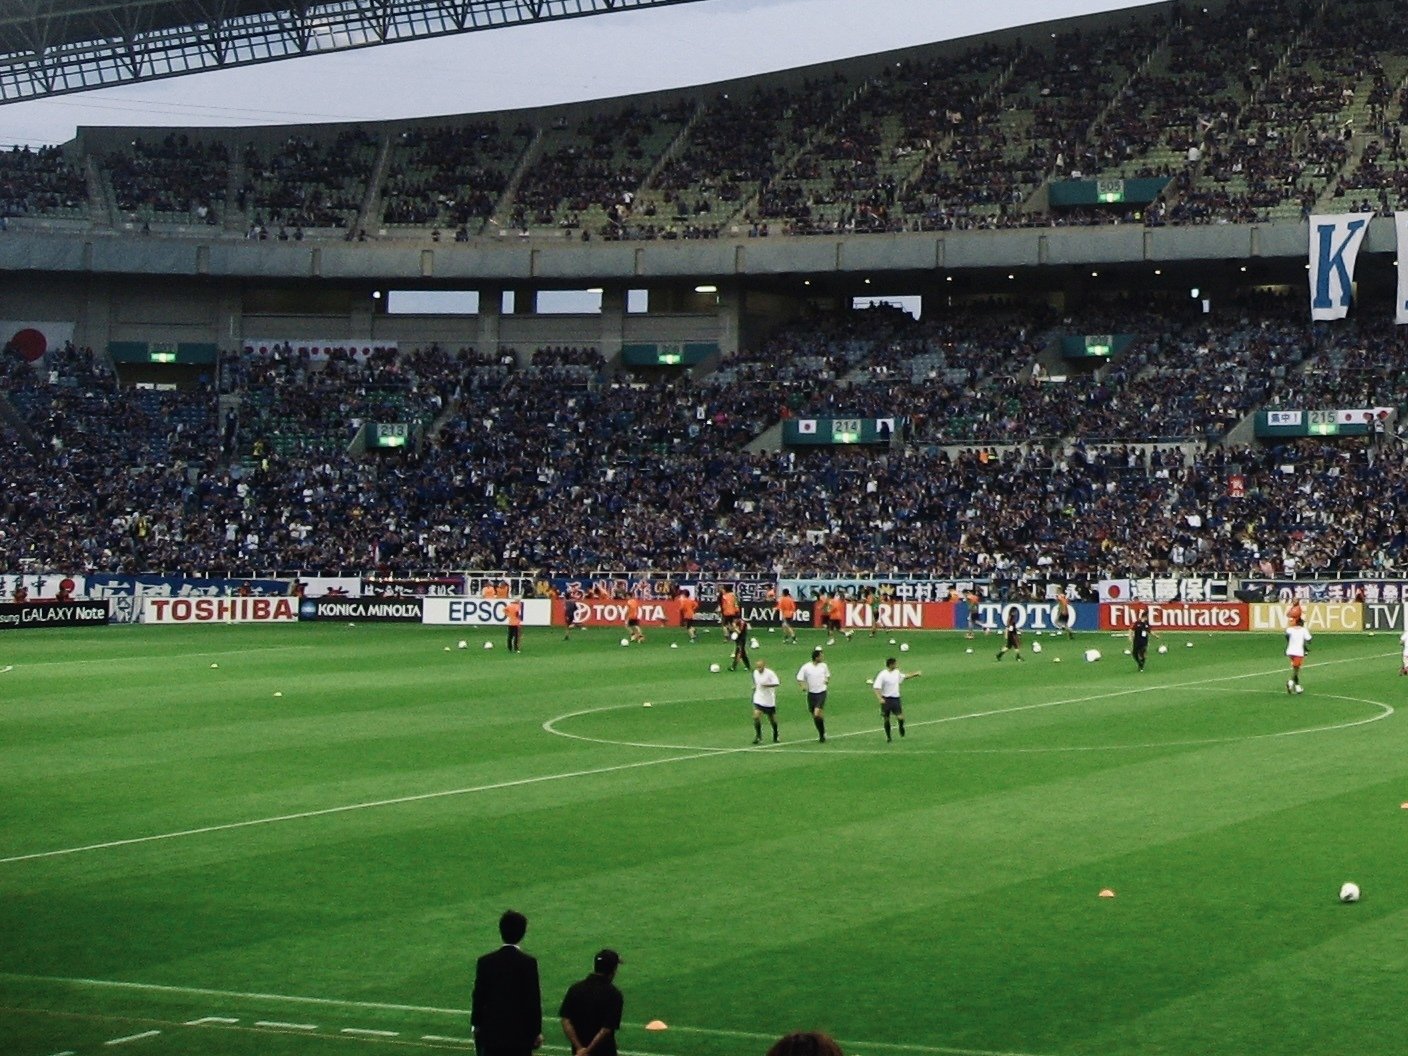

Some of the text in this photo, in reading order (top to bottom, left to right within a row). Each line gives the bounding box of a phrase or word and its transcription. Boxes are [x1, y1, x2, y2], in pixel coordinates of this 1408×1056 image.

[834, 420, 858, 432] 214
[1311, 411, 1335, 424] 215
[22, 607, 74, 622] GALAXY
[75, 606, 105, 620] Note
[151, 599, 293, 621] TOSHIBA
[318, 603, 421, 617] KONICA MINOLTA
[449, 601, 524, 622] EPSO
[593, 605, 666, 621] TOYTA
[845, 603, 922, 628] KIRIN
[978, 603, 1076, 628] TOTO
[1147, 604, 1241, 626] Emirates
